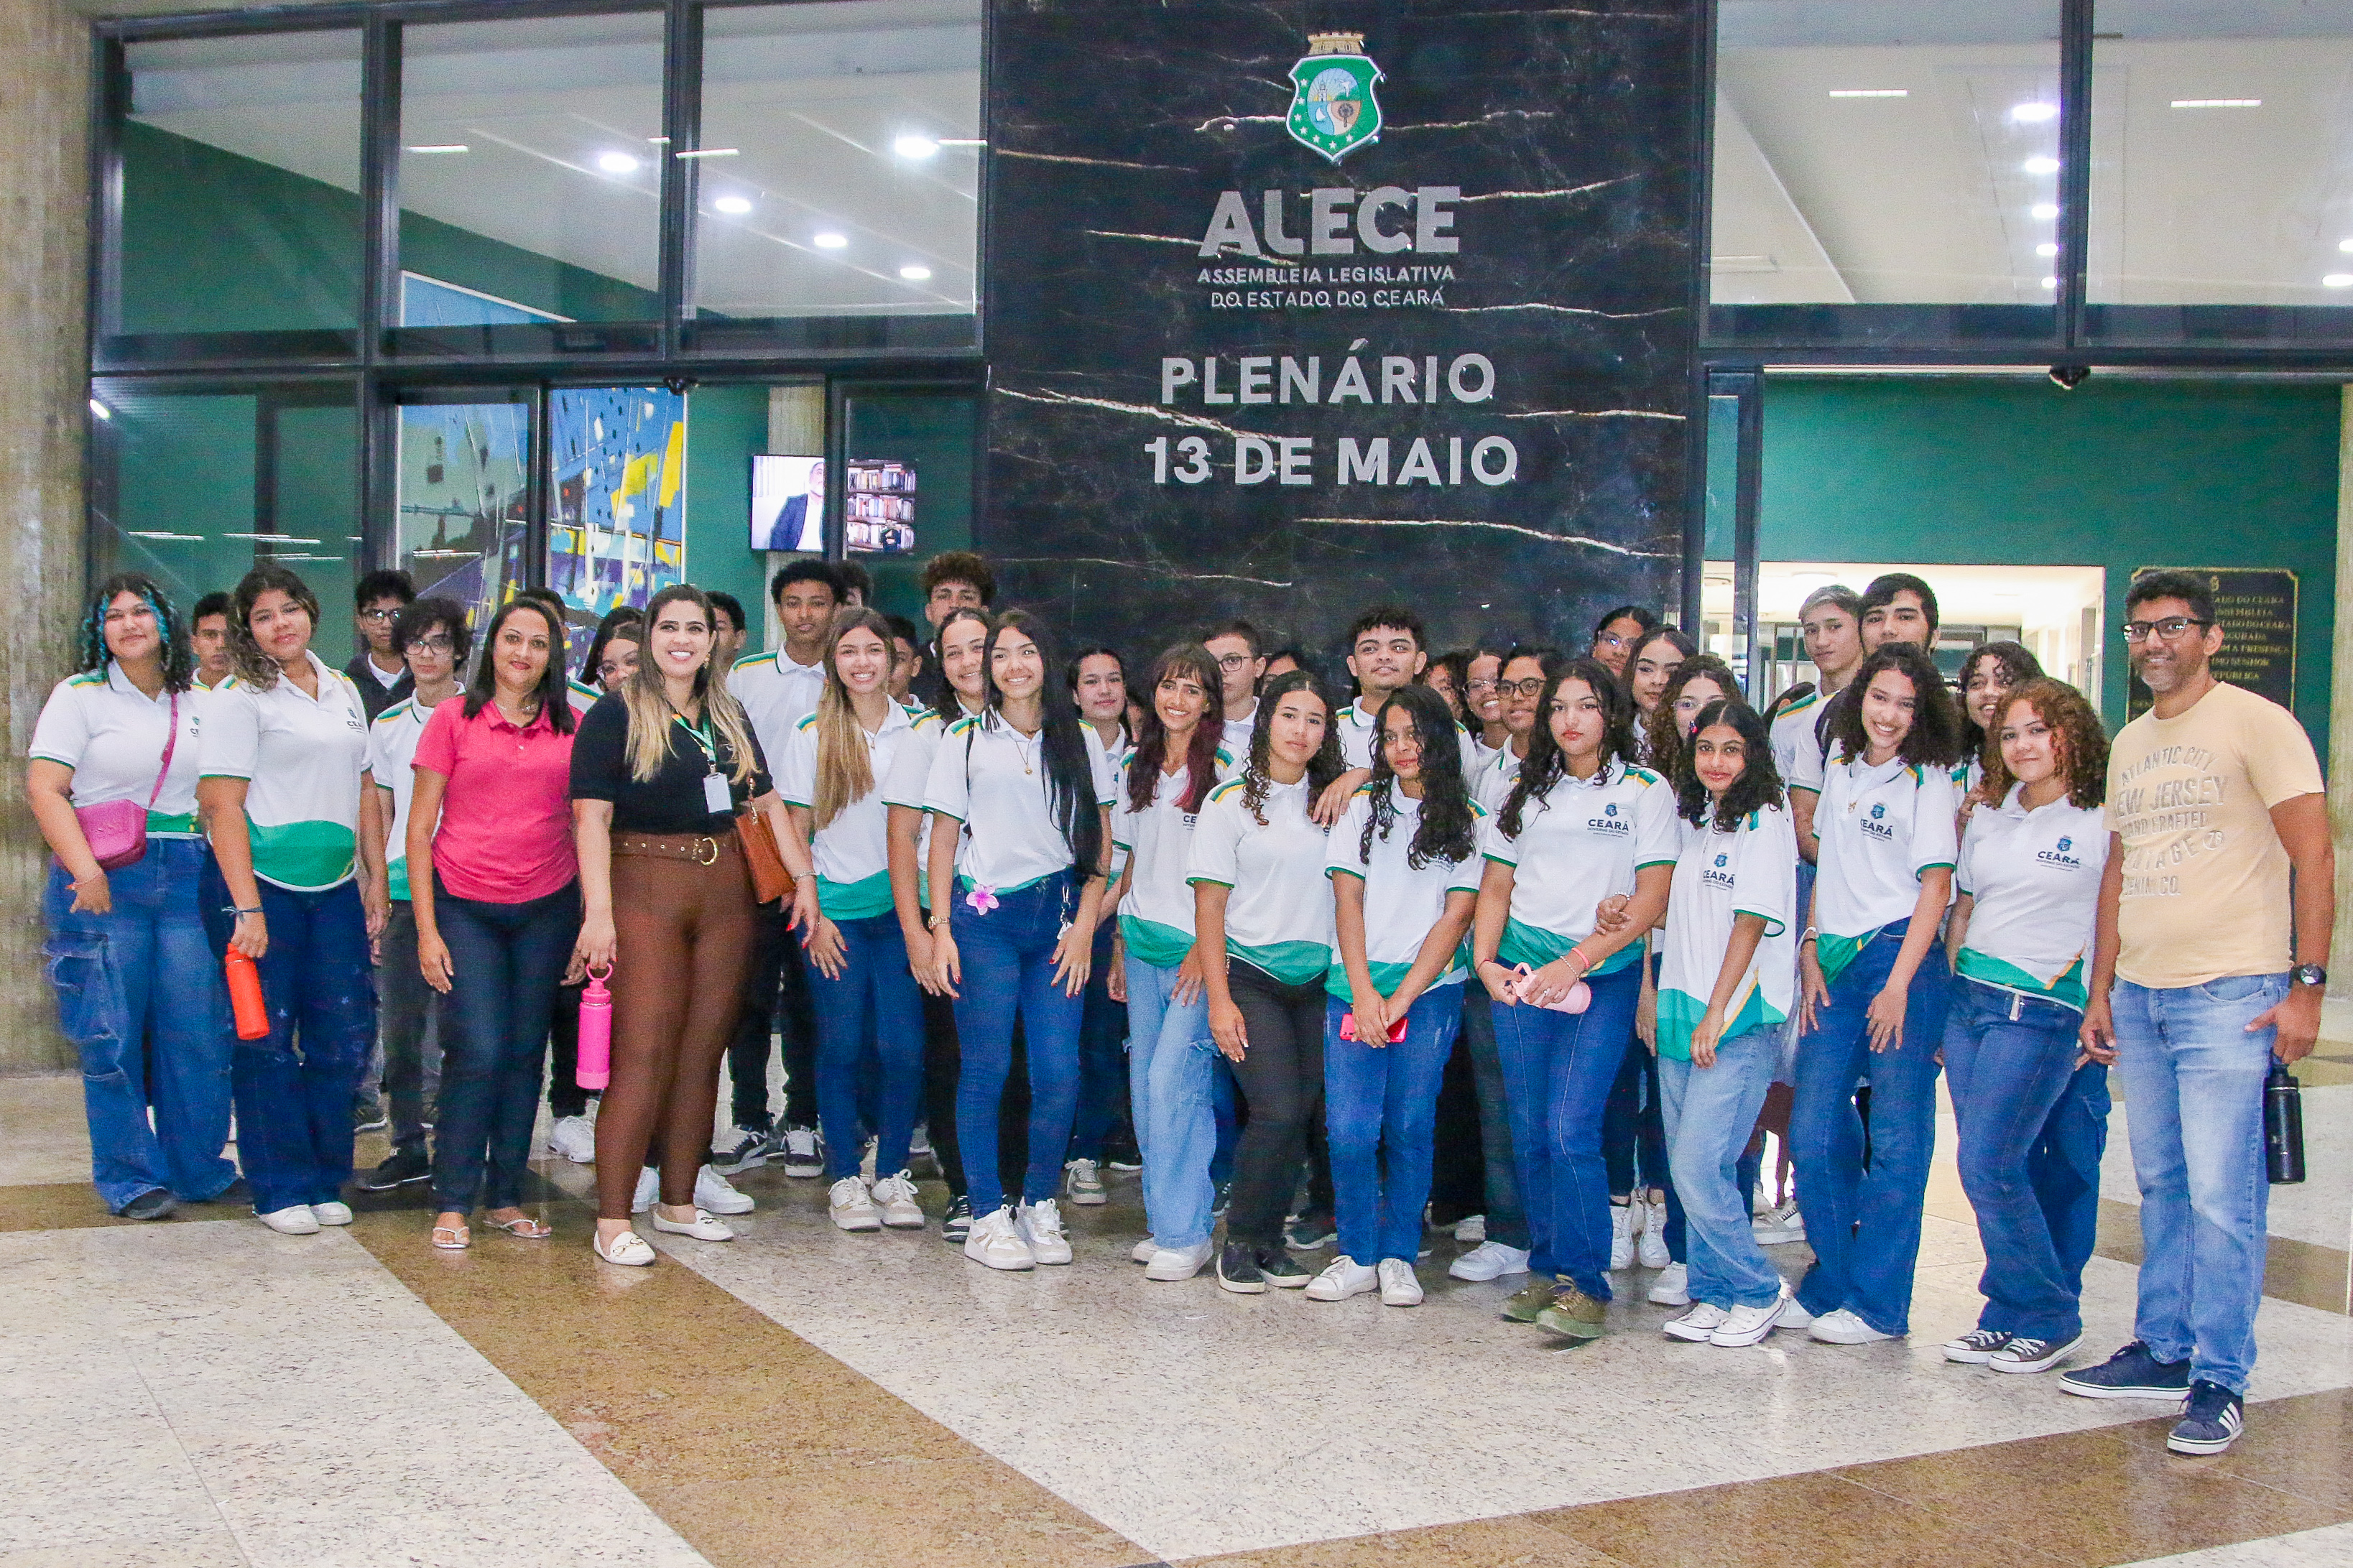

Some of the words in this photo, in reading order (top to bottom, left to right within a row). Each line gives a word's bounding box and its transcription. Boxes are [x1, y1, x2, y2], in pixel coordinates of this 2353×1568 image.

[1198, 185, 1461, 256] ALECE
[1198, 267, 1322, 284] ASSEMBLEIA
[1329, 265, 1455, 282] LEGISLATIVA
[1211, 291, 1242, 307] DO
[1247, 290, 1330, 307] ESTADO
[1337, 289, 1367, 307] DO
[1373, 286, 1445, 307] CEARÁ
[1162, 338, 1495, 404] PLENÁRIO
[1145, 435, 1212, 483] 13
[1235, 437, 1313, 484] DE
[1337, 435, 1517, 486] MAIO
[2121, 746, 2181, 787] ATLANTIC
[2183, 746, 2219, 773] CITY
[2114, 787, 2145, 819] EW
[2149, 776, 2227, 812] JERSEY
[1588, 819, 1629, 831] CEARÁ
[2038, 850, 2081, 865] CEARÁ
